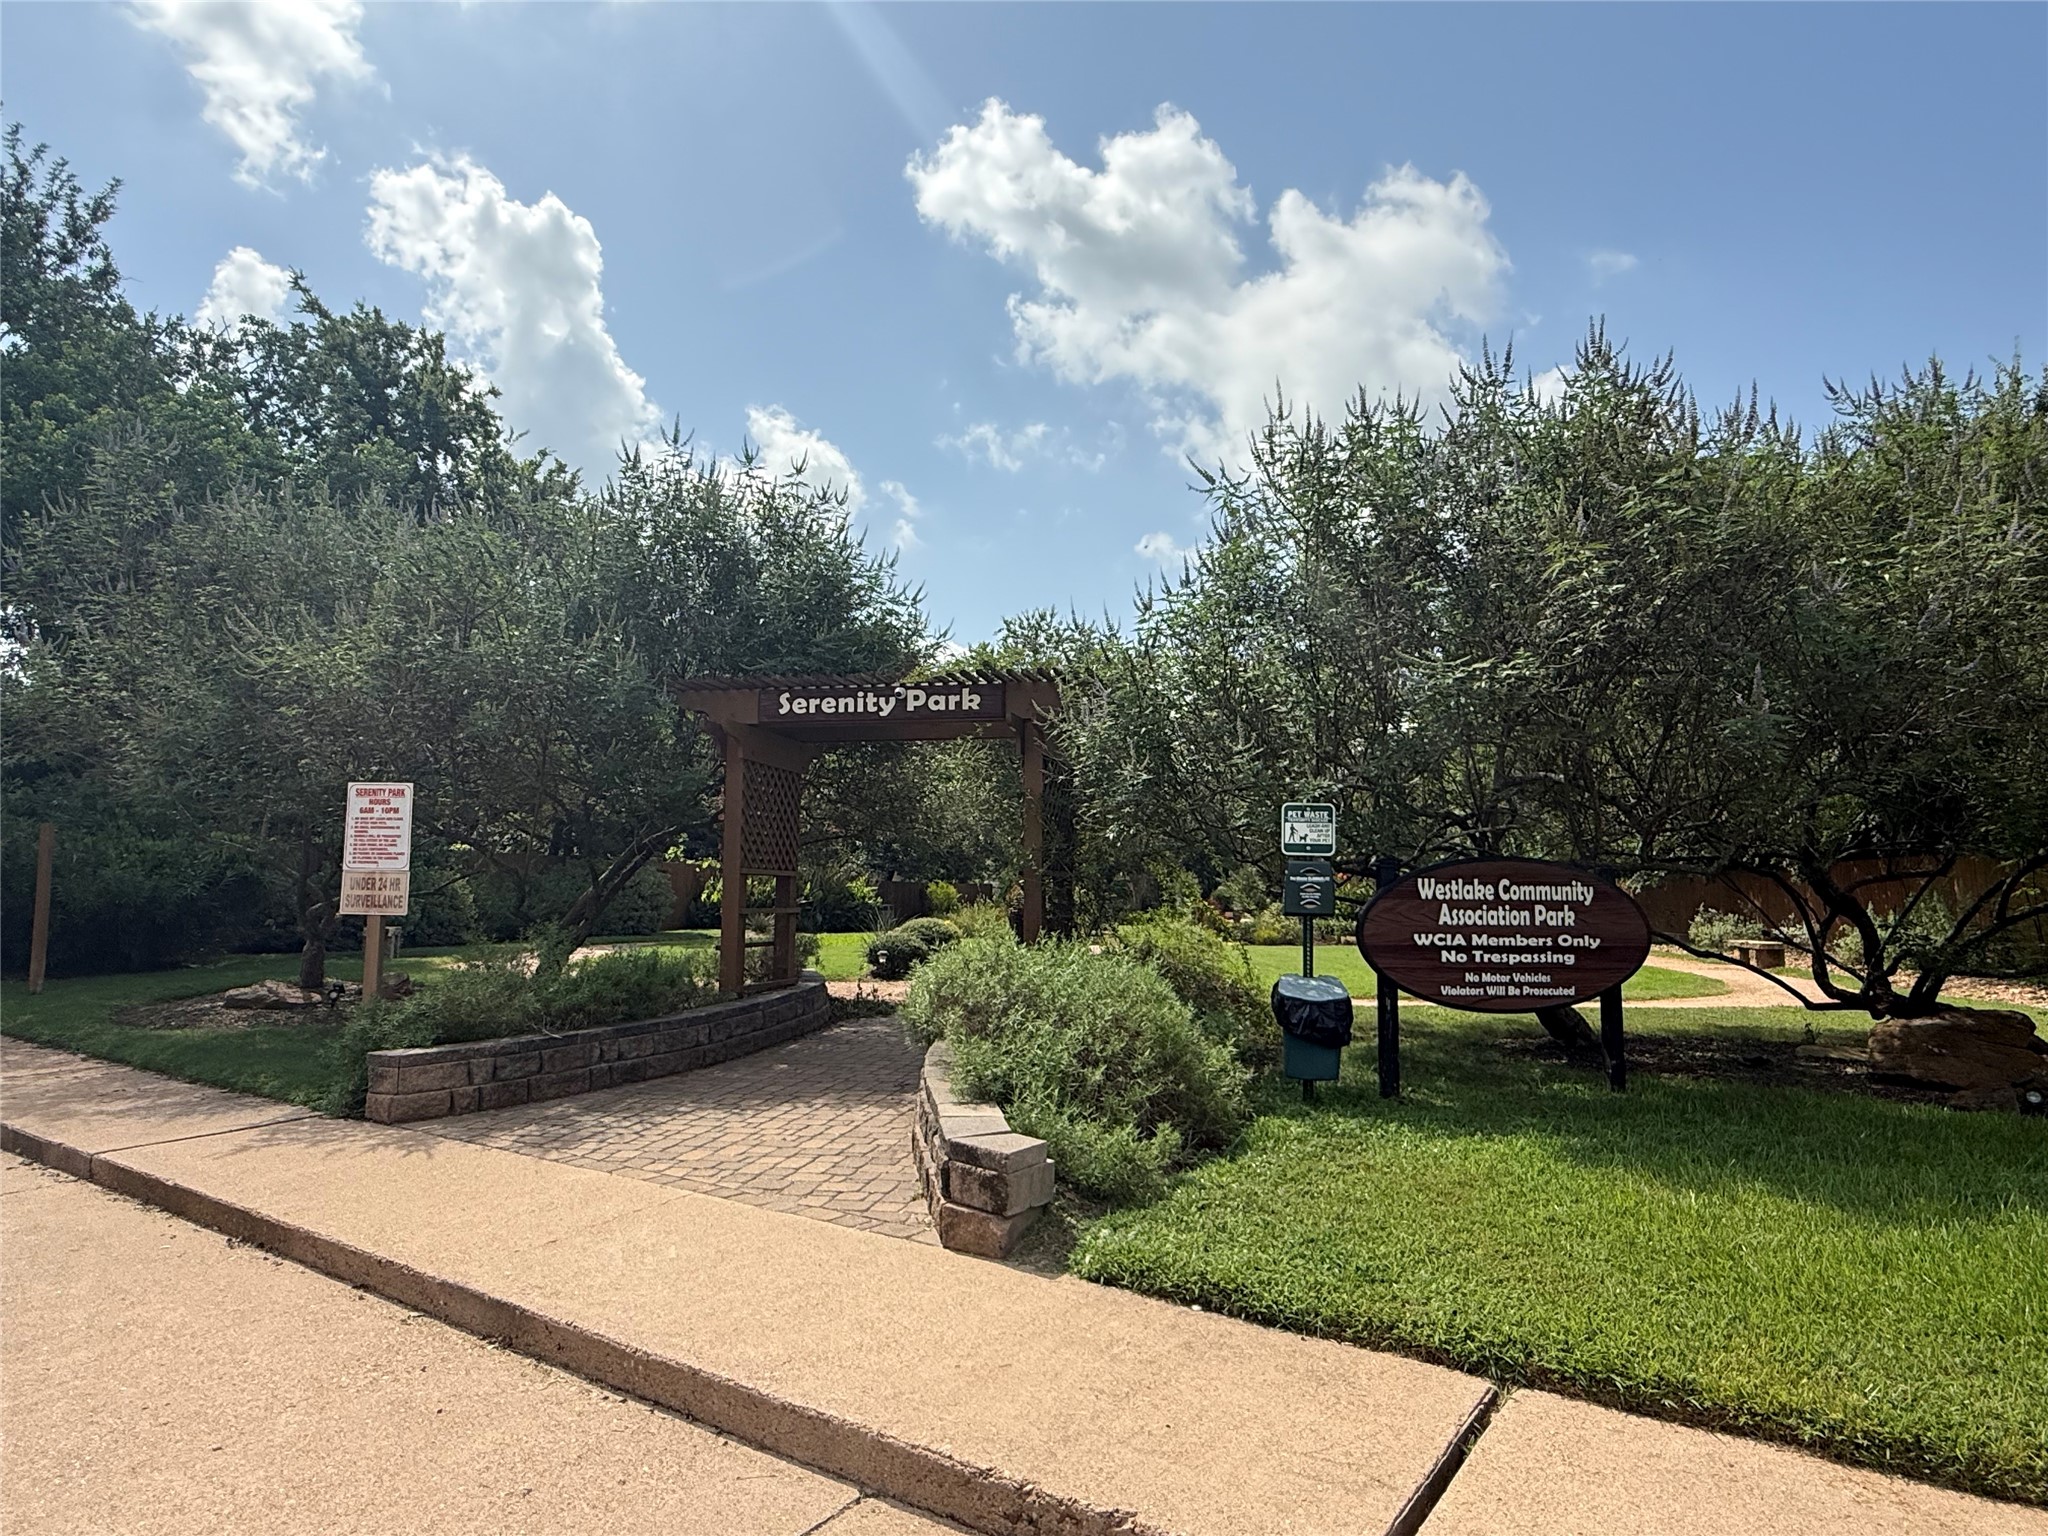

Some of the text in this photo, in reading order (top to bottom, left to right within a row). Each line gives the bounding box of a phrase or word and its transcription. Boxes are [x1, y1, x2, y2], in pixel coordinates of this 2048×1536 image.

[778, 688, 981, 716] Serenity Park
[355, 788, 405, 797] SERENITY PARK
[350, 877, 400, 891] UNDER 24 HR
[1417, 878, 1594, 906] Westlake Community
[345, 894, 403, 908] SURVEILLANCE
[1438, 904, 1576, 926] Association Park
[1414, 933, 1600, 949] WCIA Members Only
[1441, 950, 1575, 965] No Trespassing
[1465, 972, 1551, 983] No Motor Vehicles
[1441, 986, 1575, 996] Violators Will Be Prosecuted
